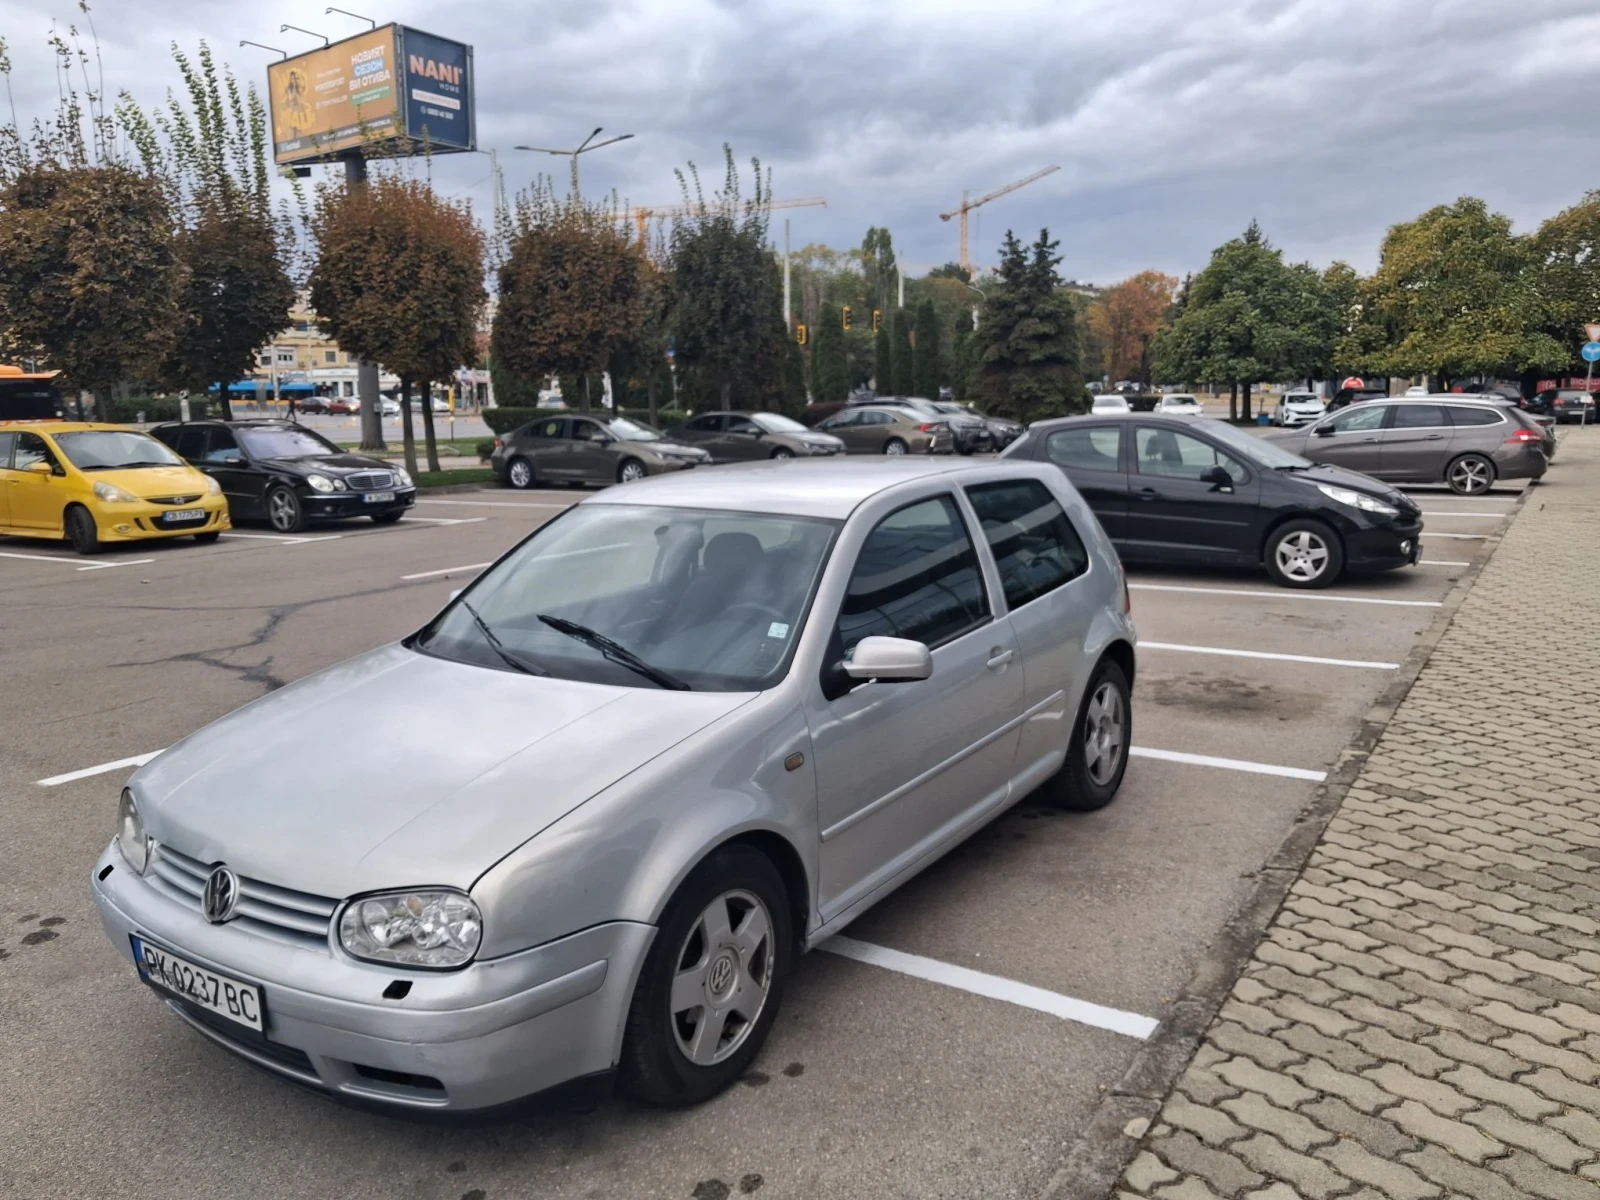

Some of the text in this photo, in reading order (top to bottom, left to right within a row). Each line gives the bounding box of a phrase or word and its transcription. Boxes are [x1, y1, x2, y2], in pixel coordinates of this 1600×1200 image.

[351, 45, 385, 65] НОВИЯТ
[354, 57, 384, 77] СЕЗОН
[409, 54, 460, 85] NANI
[349, 78, 361, 91] ВИ
[361, 69, 391, 87] ОТИВА
[439, 83, 460, 93] HOME
[144, 946, 258, 1023] PK 0237 BC
